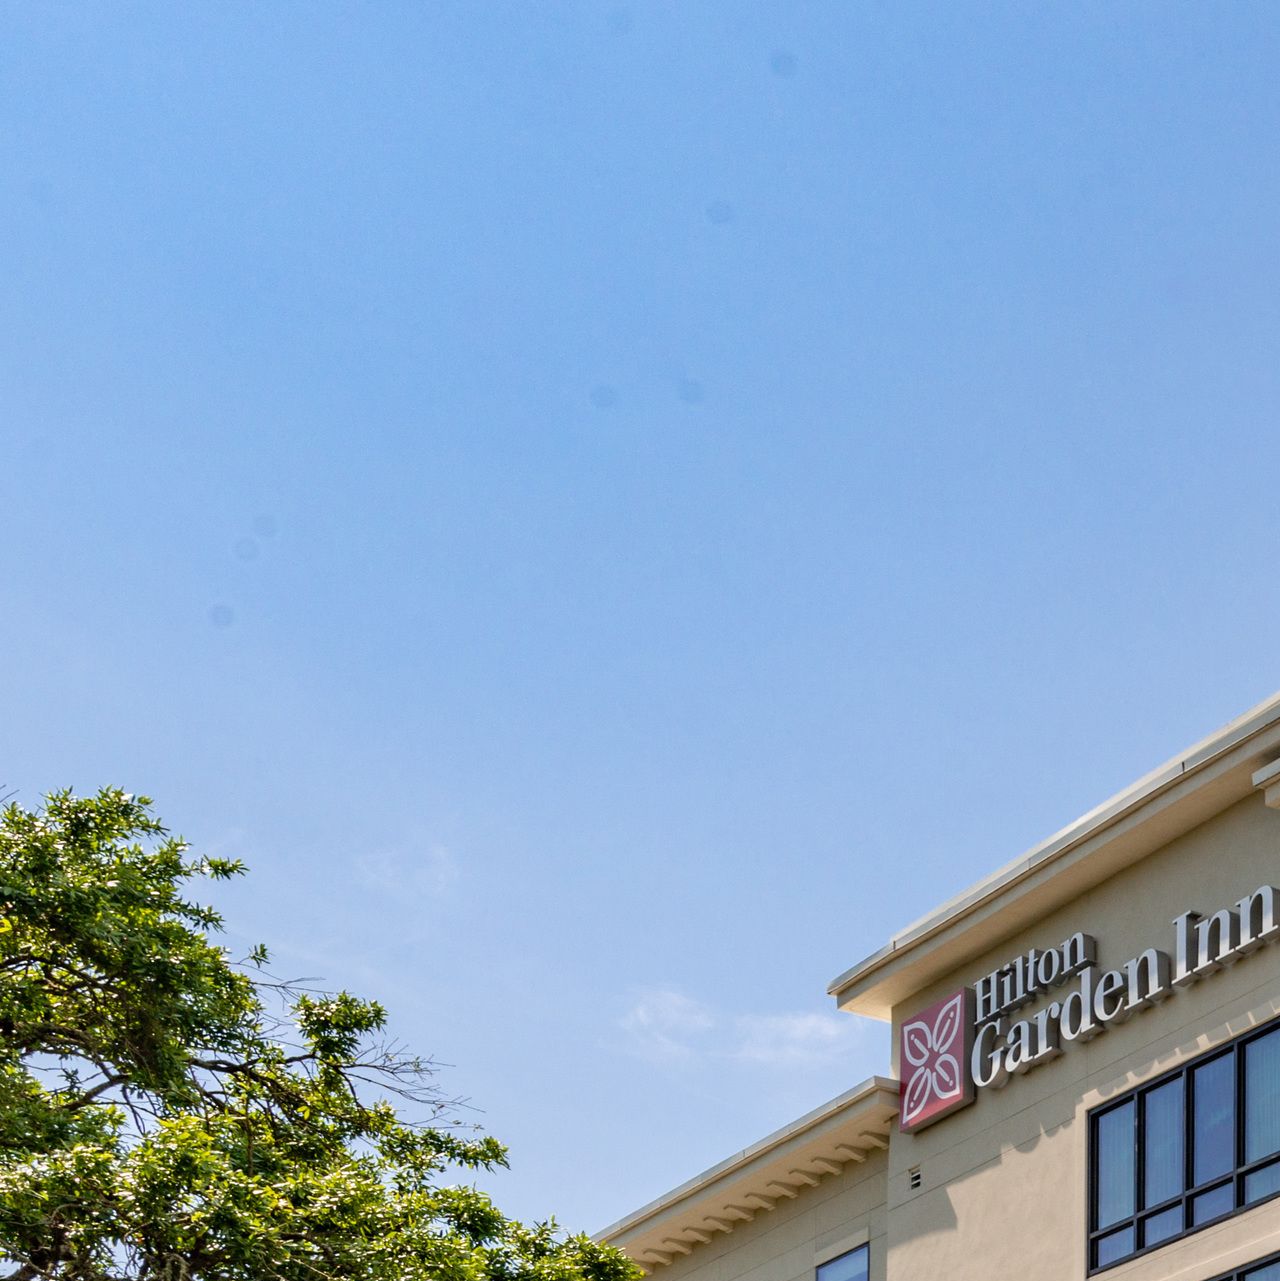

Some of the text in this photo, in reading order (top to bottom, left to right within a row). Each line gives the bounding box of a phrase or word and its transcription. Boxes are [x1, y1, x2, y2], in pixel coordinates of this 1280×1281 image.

[971, 885, 1279, 1088] Garden Inn
[974, 932, 1090, 1025] Hilton
